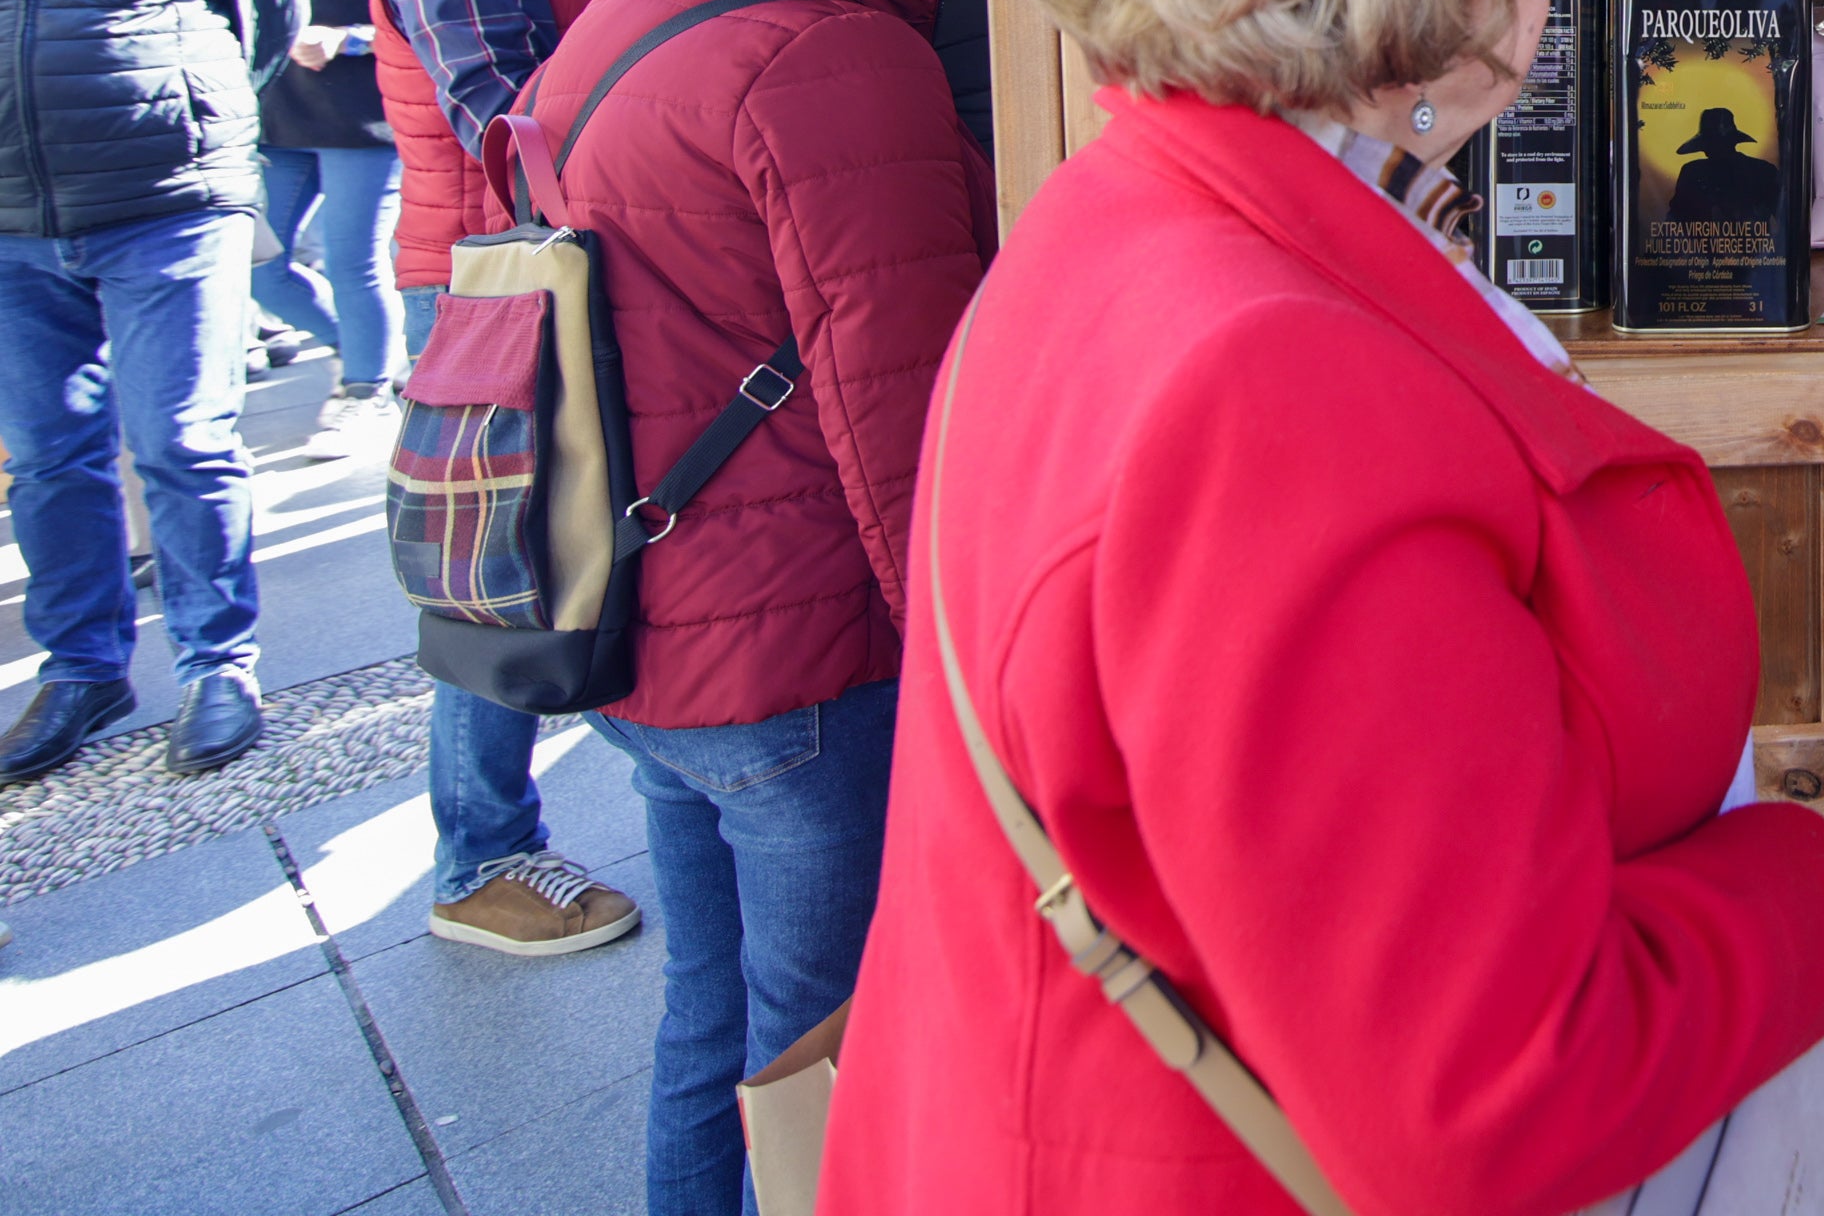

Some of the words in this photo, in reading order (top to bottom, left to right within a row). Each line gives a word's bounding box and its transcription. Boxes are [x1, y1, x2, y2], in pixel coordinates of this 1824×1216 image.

[1641, 9, 1780, 44] PARQUEOLIVA
[1651, 222, 1684, 237] EXTRA
[1686, 222, 1719, 237] VIRGIN
[1722, 222, 1751, 237] OLIVE
[1754, 222, 1770, 237] OIL
[1645, 238, 1671, 254] HUILE
[1674, 238, 1708, 254] D'OLIVE
[1710, 238, 1743, 254] VIERGE
[1746, 238, 1775, 254] EXTRA
[1694, 257, 1709, 268] Origin
[1689, 270, 1704, 281] Priego
[1704, 271, 1711, 279] de
[1659, 302, 1675, 312] 101
[1678, 302, 1689, 312] FL
[1691, 302, 1707, 312] OZ
[1749, 302, 1756, 312] 3
